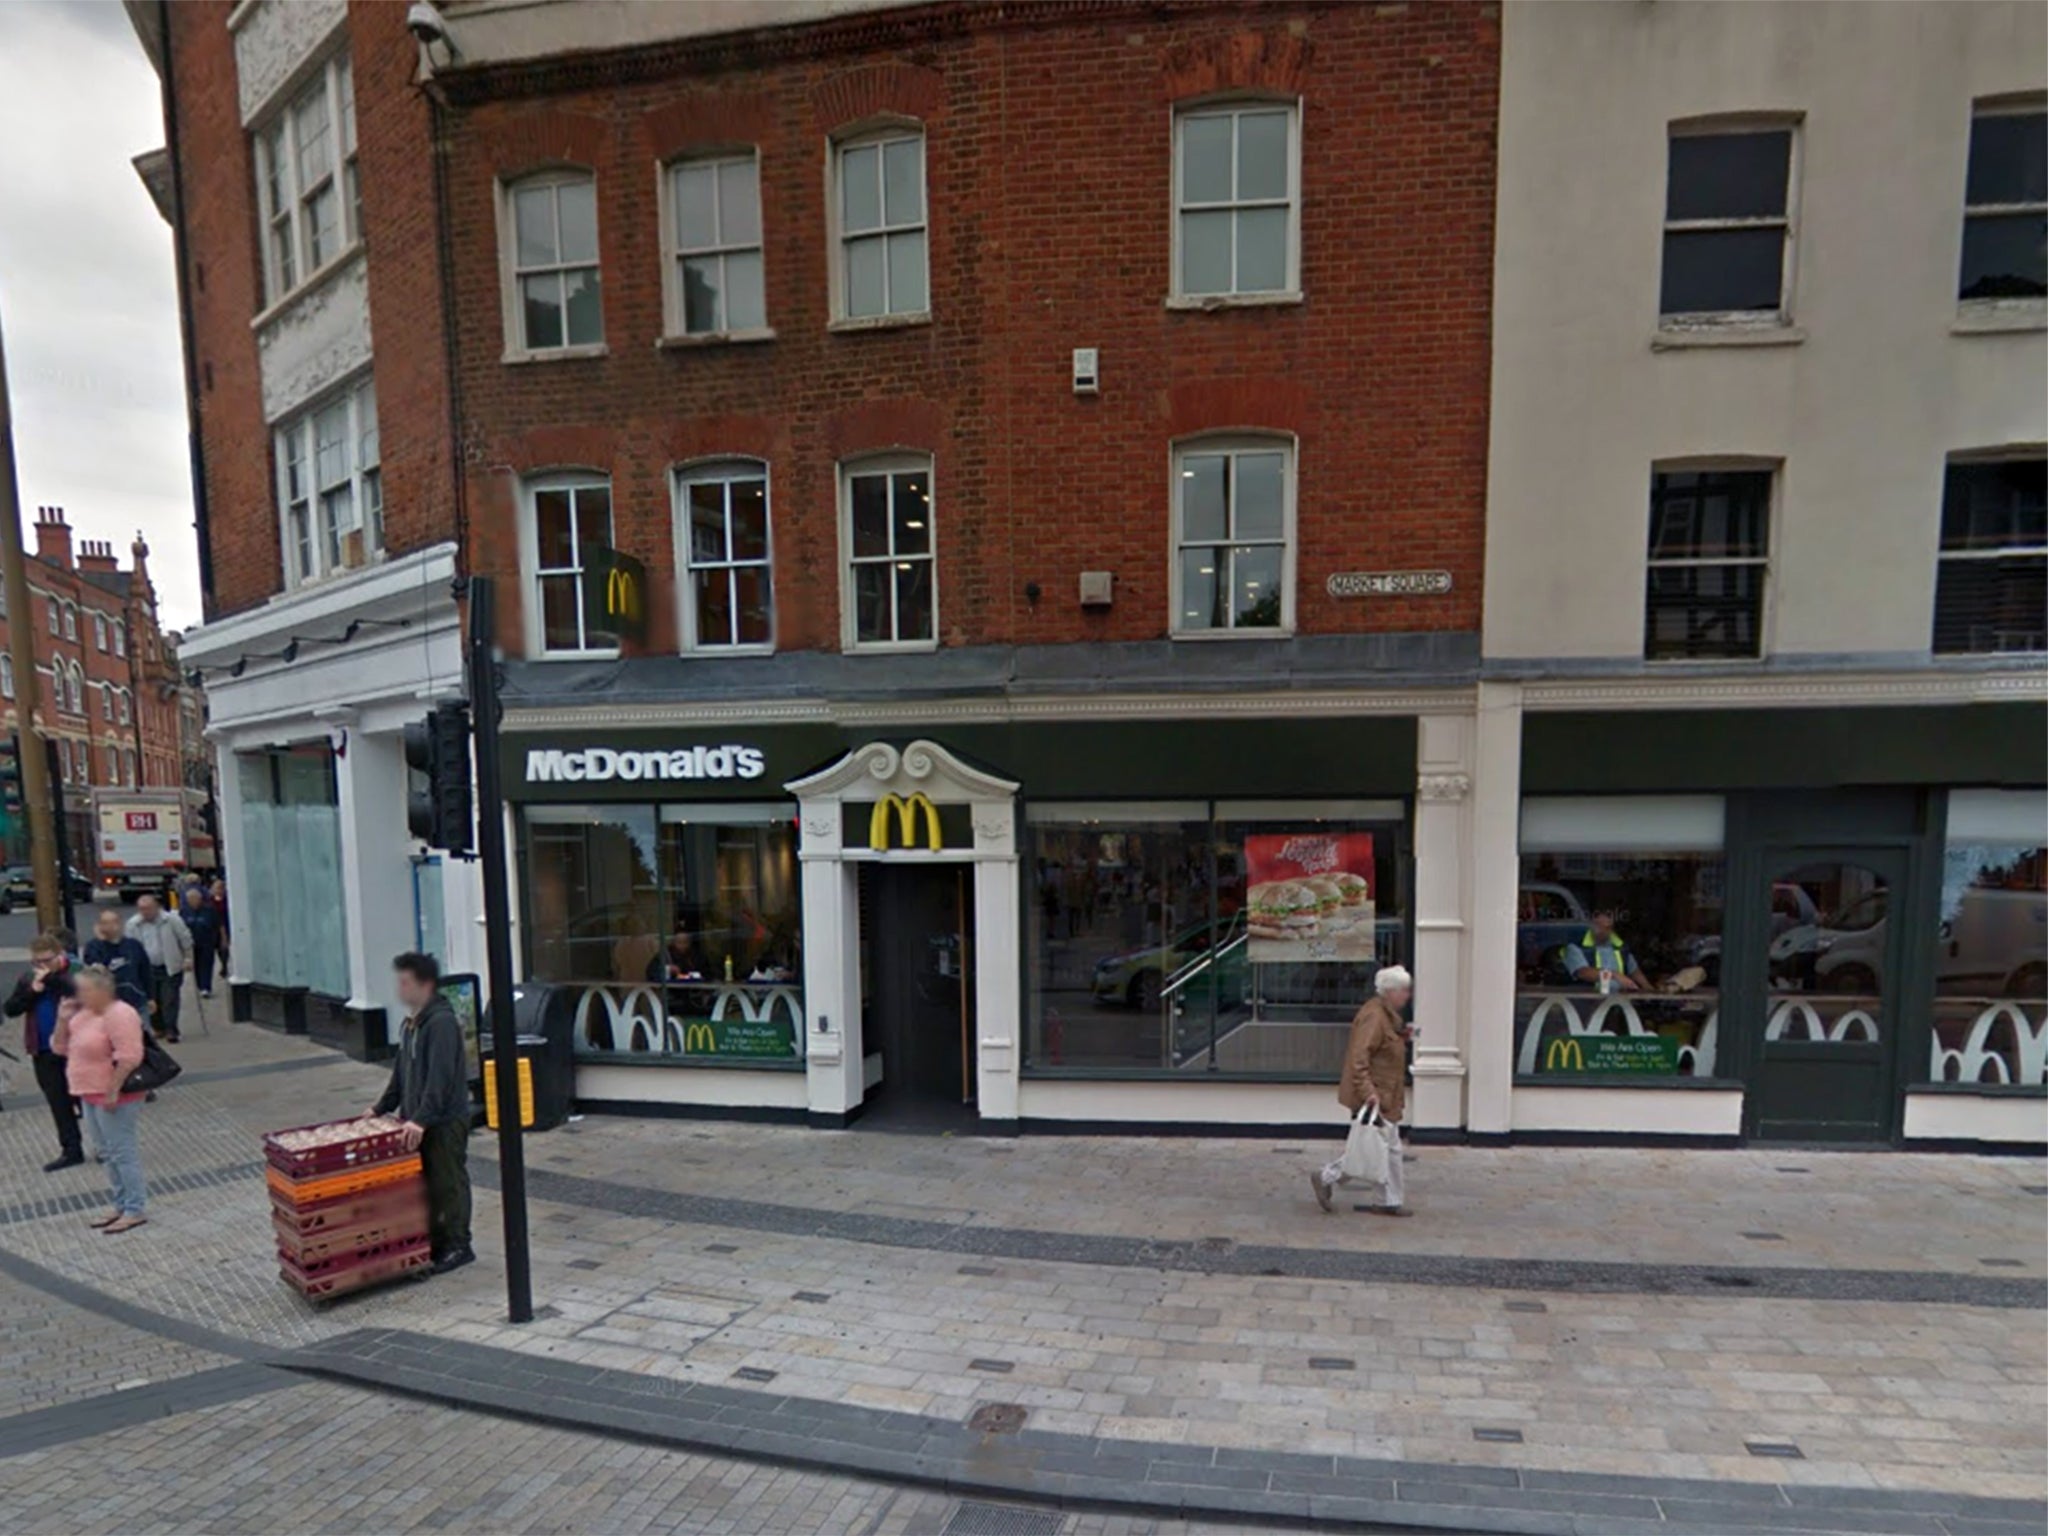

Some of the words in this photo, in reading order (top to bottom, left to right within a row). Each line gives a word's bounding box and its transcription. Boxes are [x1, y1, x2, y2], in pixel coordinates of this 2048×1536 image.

[1334, 574, 1387, 592] MARKET
[1391, 573, 1443, 591] SQUARE
[526, 745, 766, 783] McDonald's
[1635, 1042, 1663, 1054] Open
